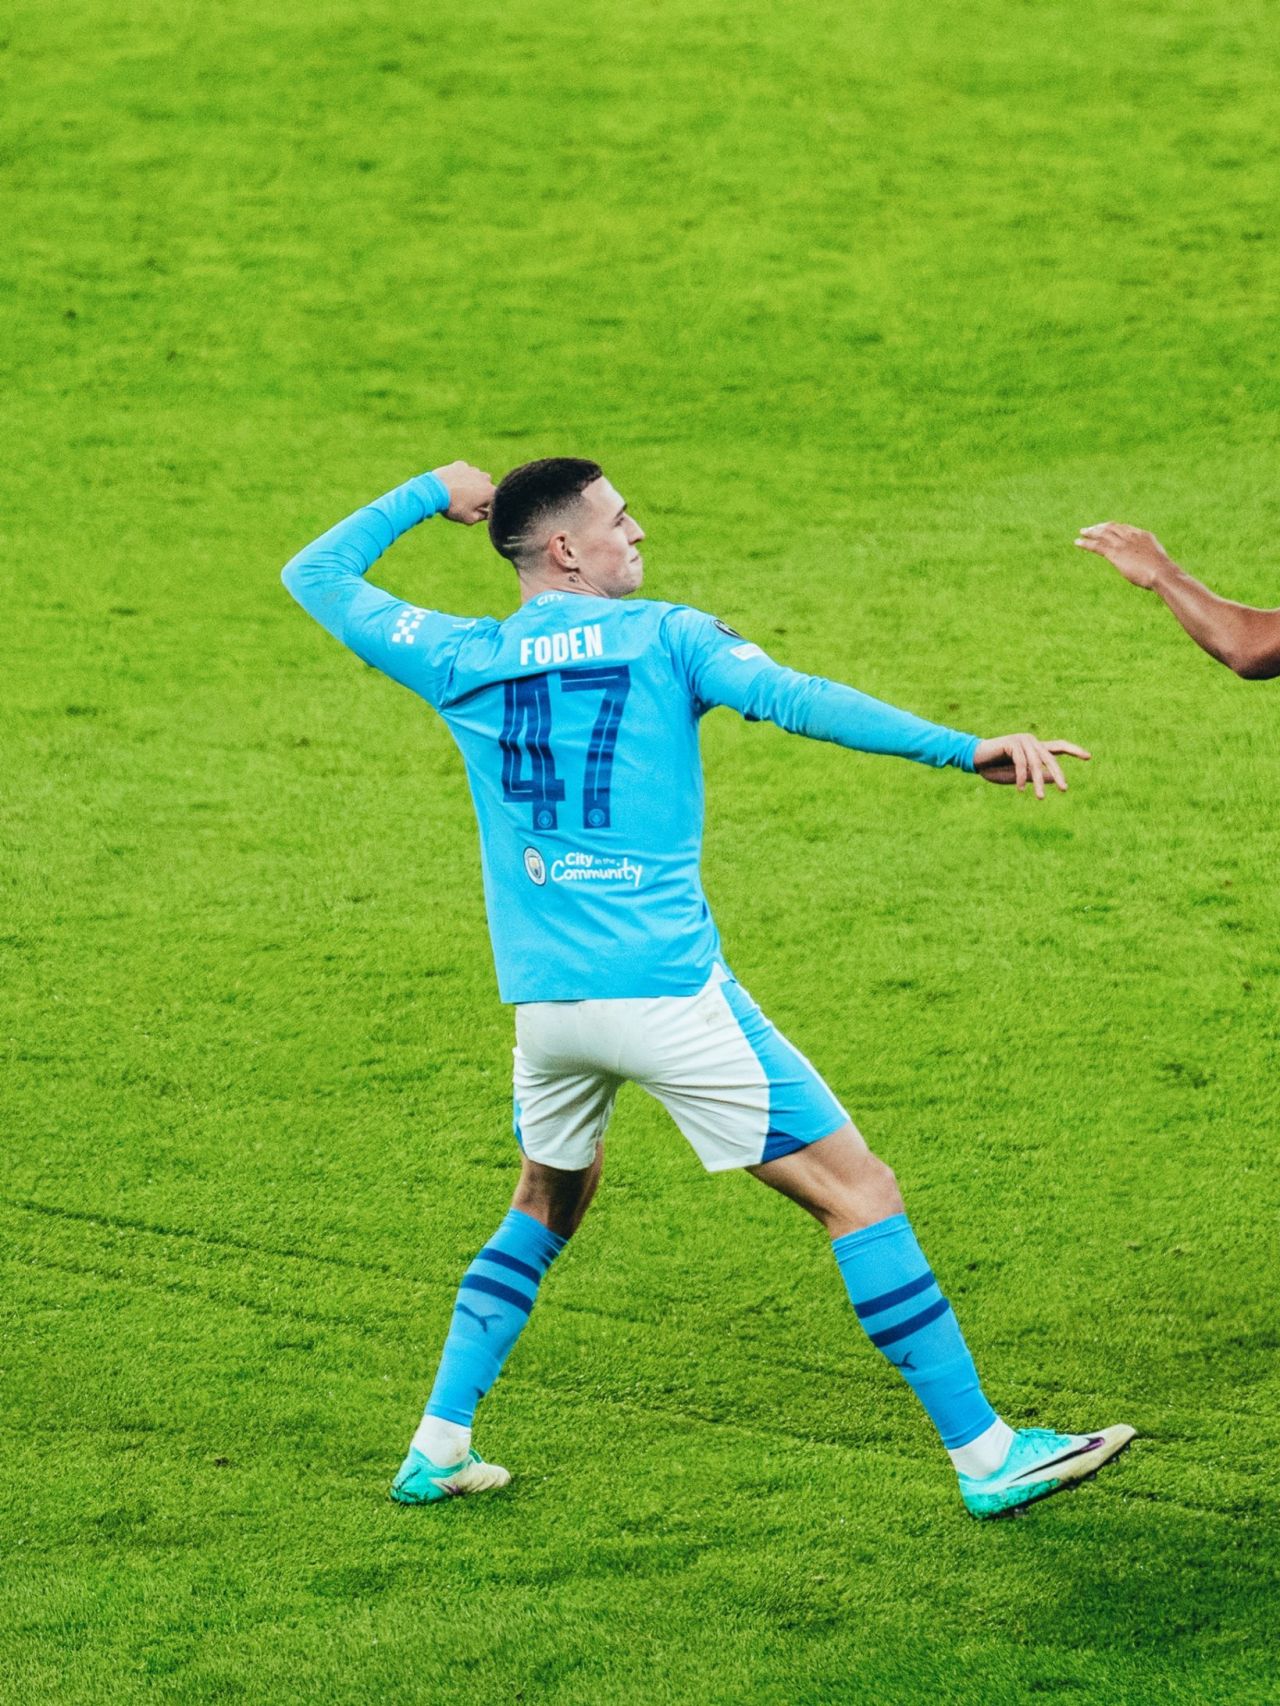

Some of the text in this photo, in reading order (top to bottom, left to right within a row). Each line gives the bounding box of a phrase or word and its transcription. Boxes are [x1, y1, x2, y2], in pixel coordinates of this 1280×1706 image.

[536, 593, 565, 606] CITY
[520, 623, 604, 666] FODEN
[499, 664, 631, 830] 47
[551, 857, 643, 888] Community
[565, 852, 593, 867] City
